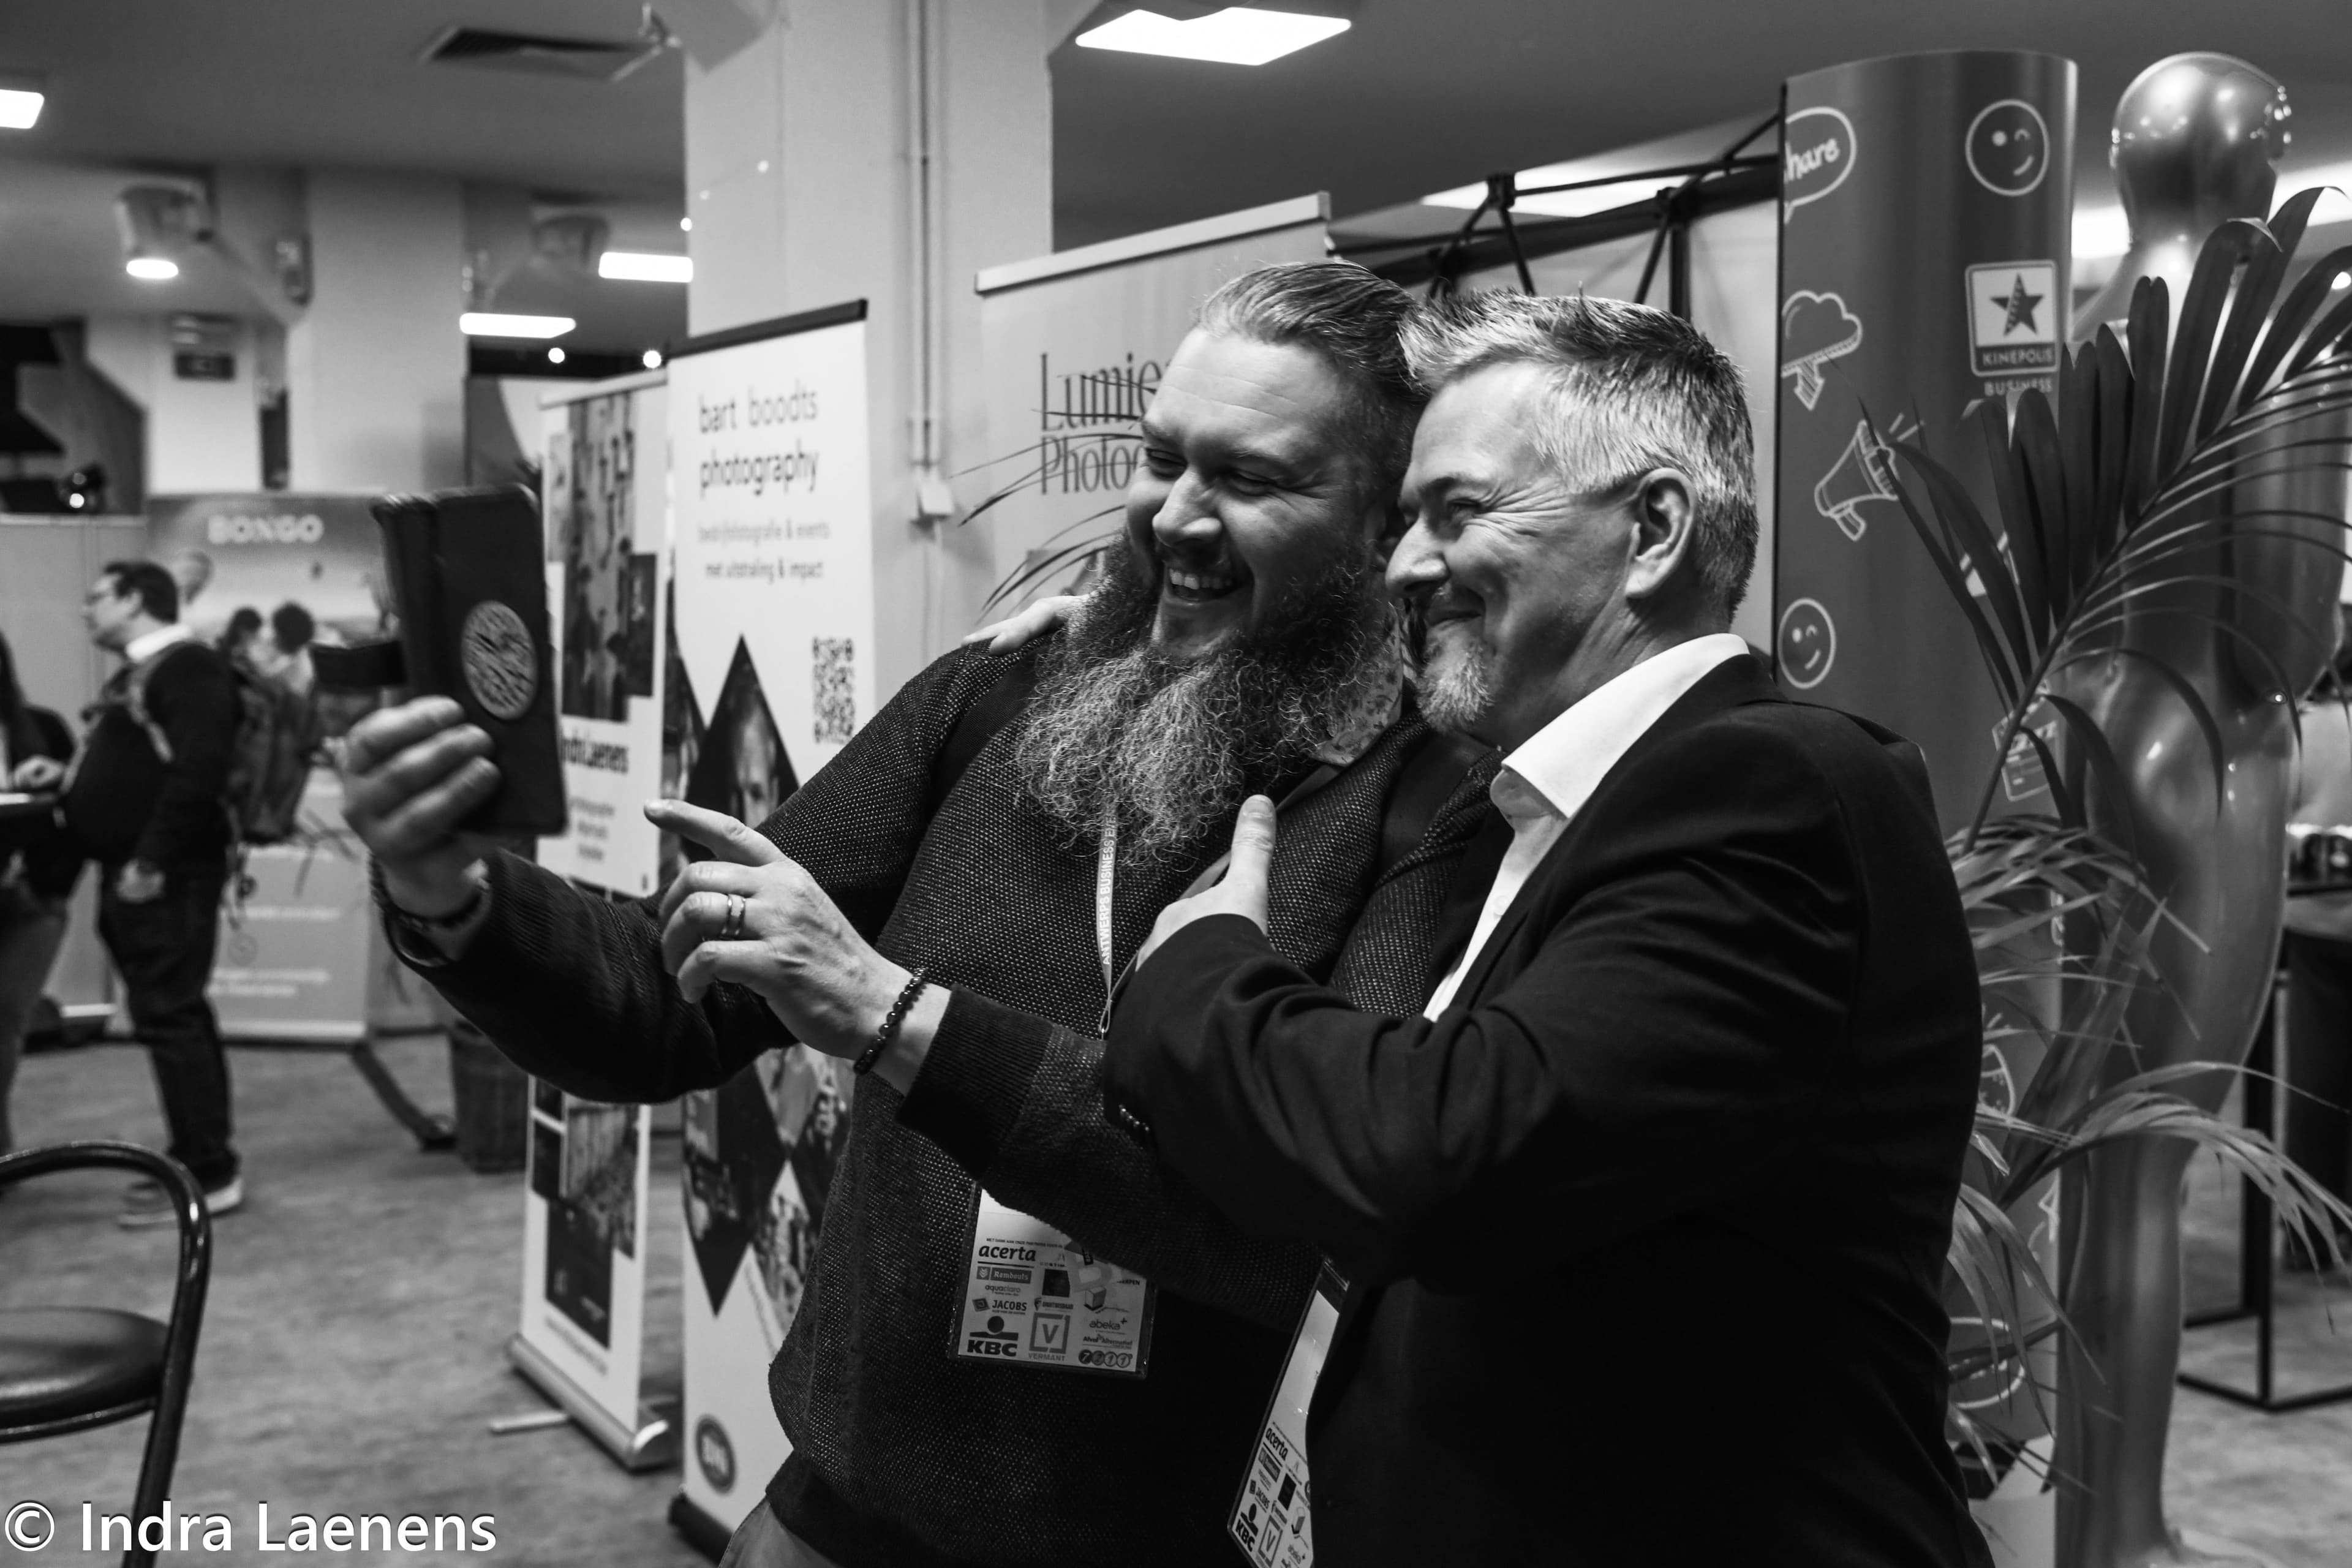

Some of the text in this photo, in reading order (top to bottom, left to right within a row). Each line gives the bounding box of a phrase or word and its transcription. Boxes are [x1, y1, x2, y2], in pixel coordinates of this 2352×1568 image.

[1784, 139, 1839, 183] hare
[1982, 347, 2052, 366] KINEPOLIS
[698, 379, 817, 434] bart boodts
[1041, 353, 1166, 431] Lumie
[699, 438, 820, 502] photography
[208, 513, 324, 543] BONGO
[979, 1245, 1036, 1261] acerta
[992, 1300, 1027, 1311] JACOBS
[967, 1340, 1018, 1357] KBC
[1029, 1352, 1066, 1361] VERMANT
[1265, 1428, 1288, 1460] acerta
[1235, 1519, 1254, 1552] KBC
